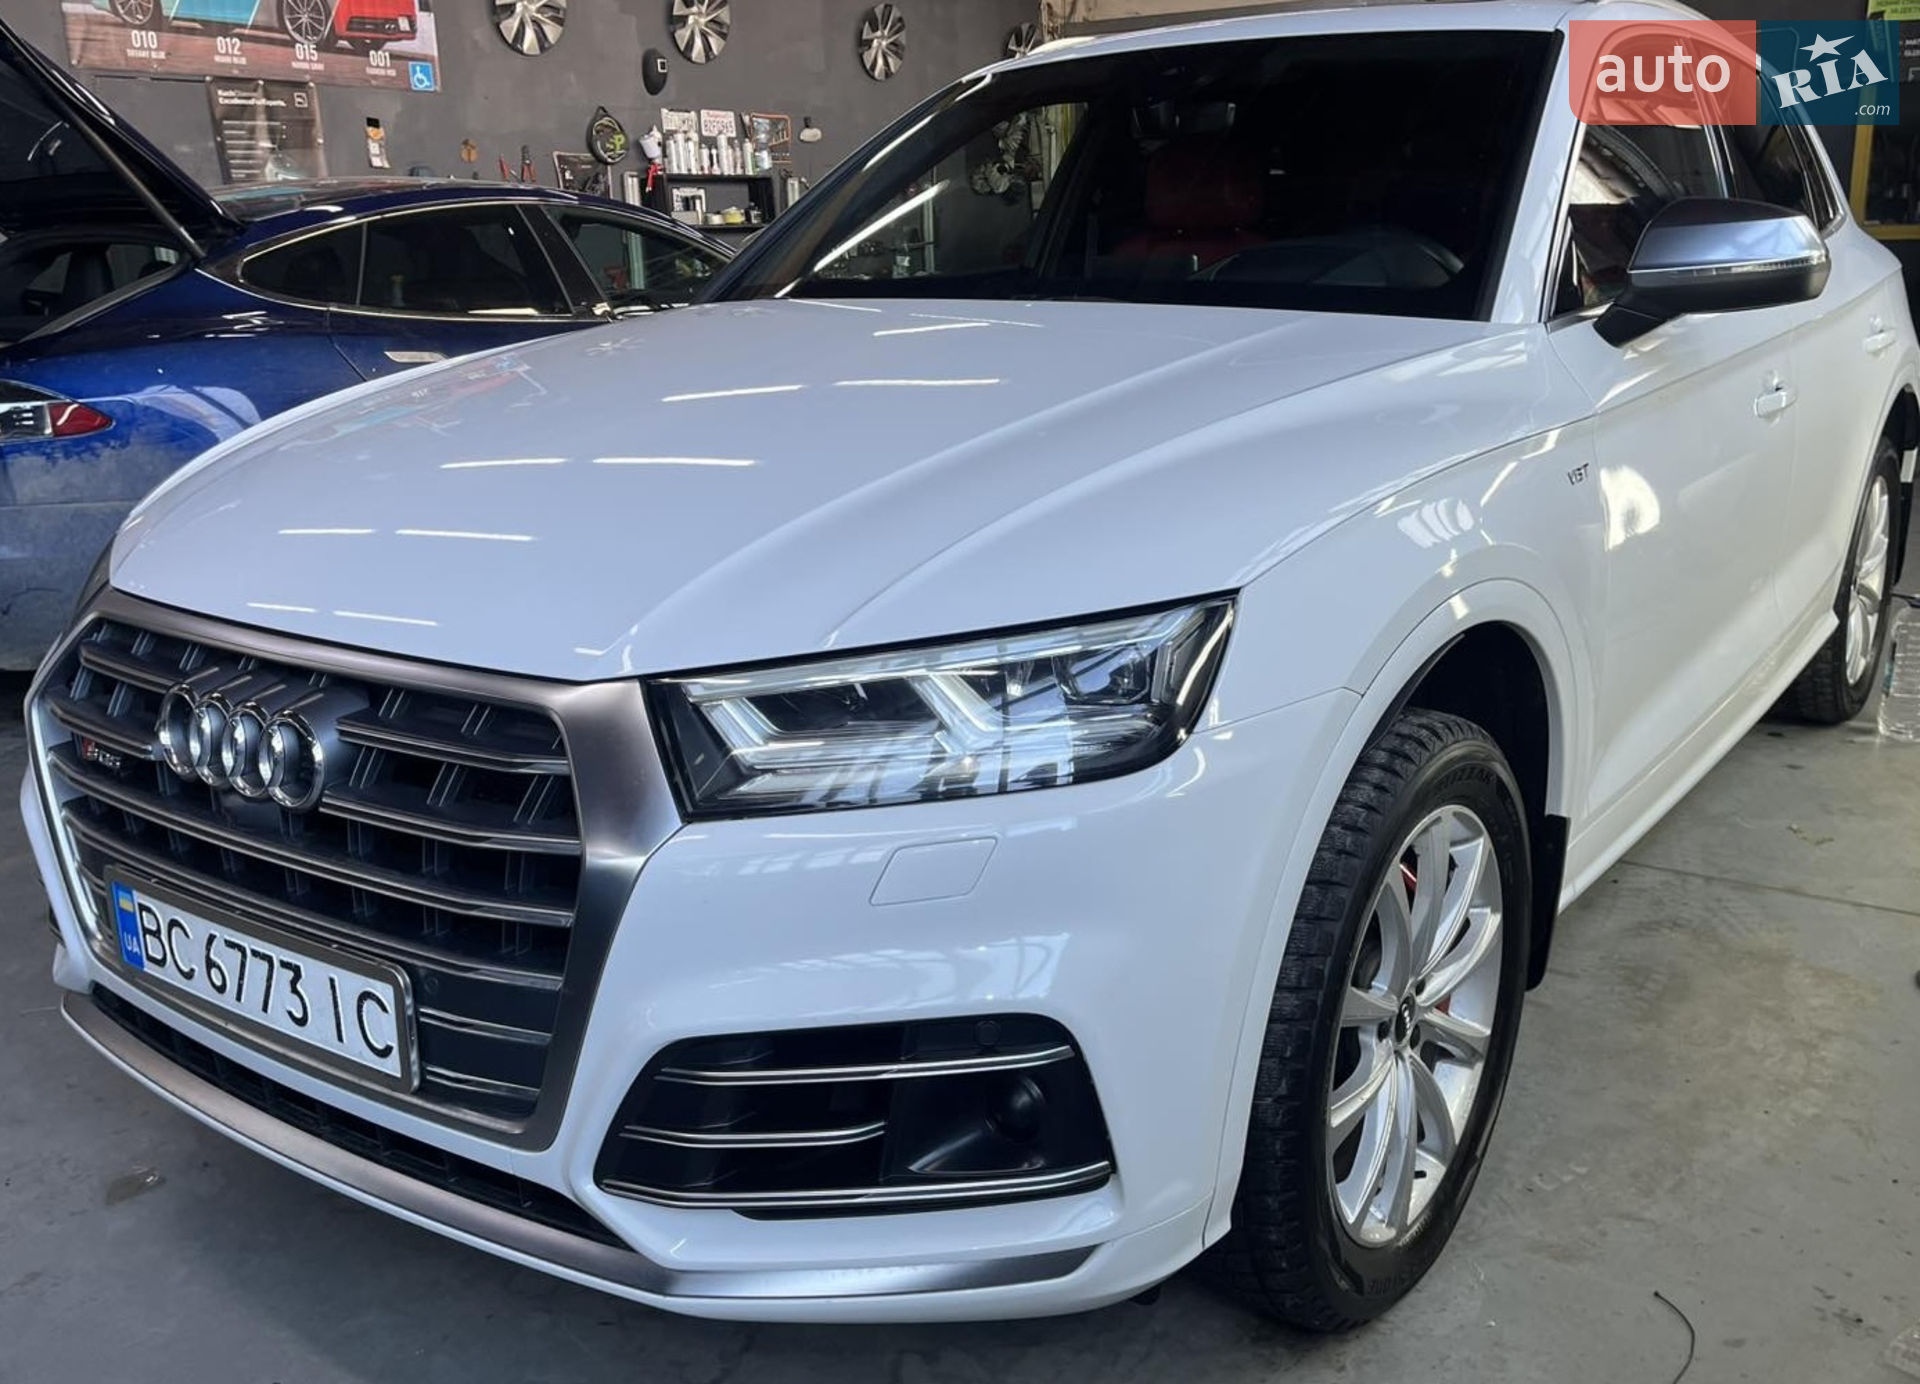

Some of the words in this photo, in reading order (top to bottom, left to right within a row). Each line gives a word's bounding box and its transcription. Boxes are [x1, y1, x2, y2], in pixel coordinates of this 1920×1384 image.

[131, 30, 158, 49] 010
[216, 36, 242, 55] 012
[295, 43, 318, 61] 015
[369, 50, 391, 67] 001
[123, 932, 140, 954] UA
[140, 902, 196, 981] BC
[205, 933, 310, 1028] 6773
[329, 976, 394, 1059] IC
